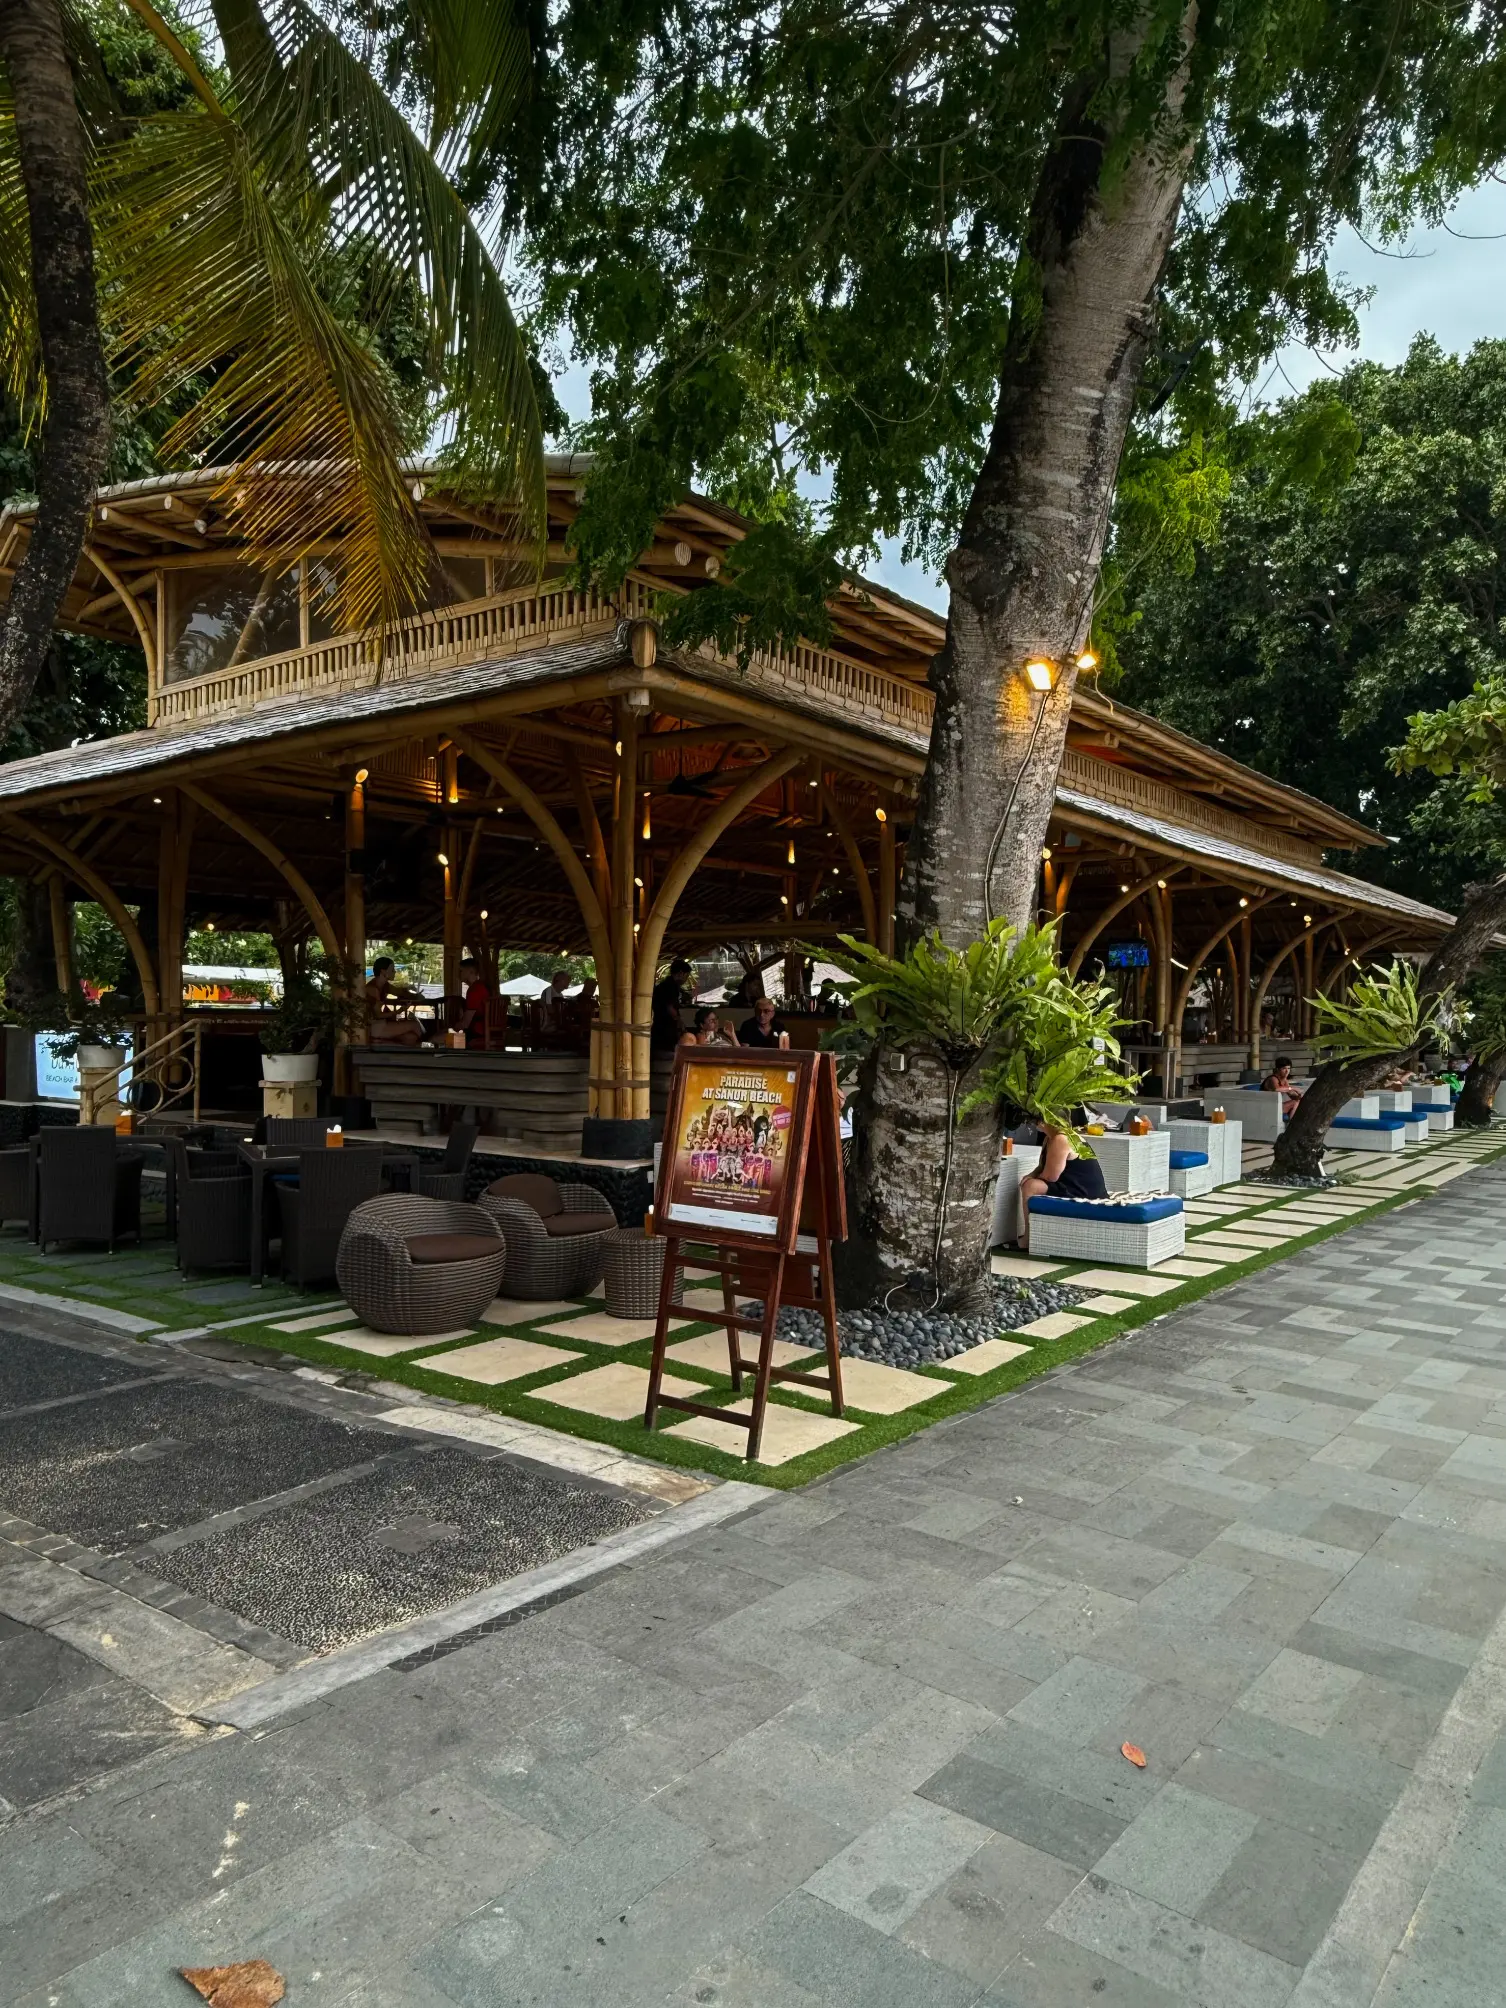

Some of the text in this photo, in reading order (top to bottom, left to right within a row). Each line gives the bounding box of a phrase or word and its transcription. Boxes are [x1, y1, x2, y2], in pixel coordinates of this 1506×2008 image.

[720, 1075, 768, 1089] PARADISE
[702, 1087, 782, 1103] AT SANUR BEACH
